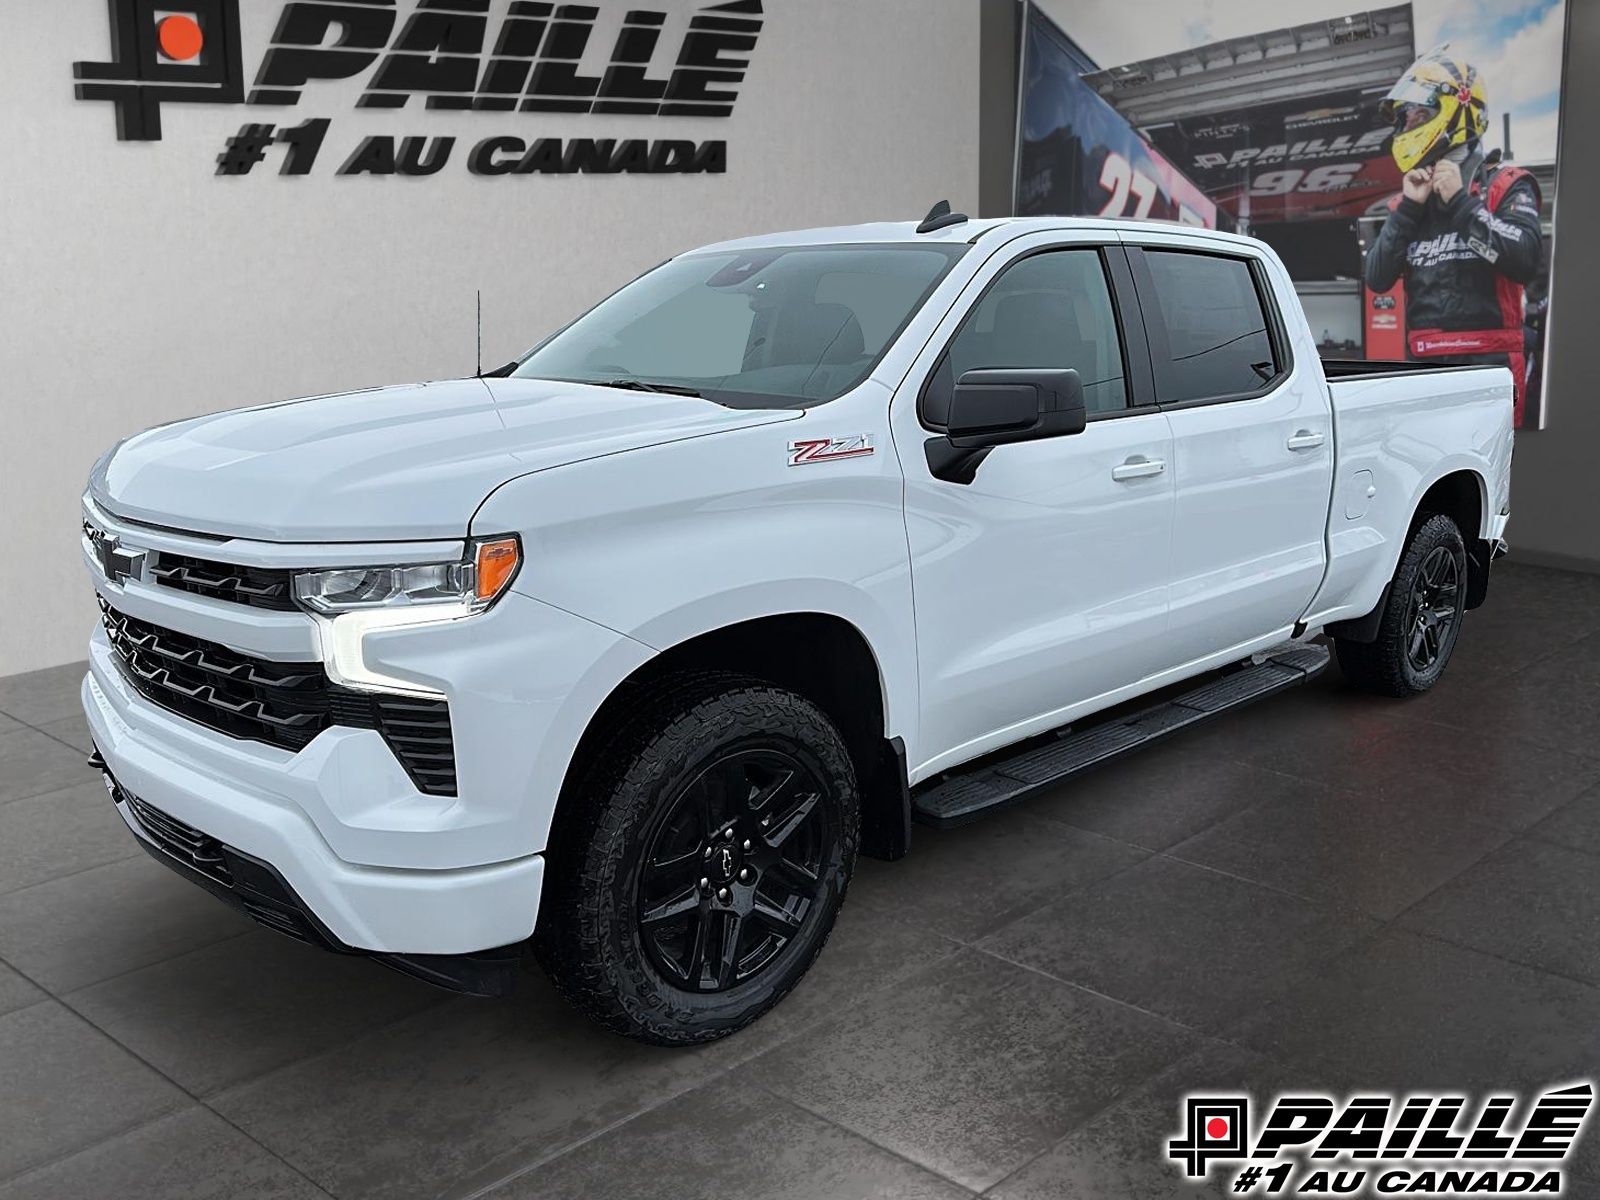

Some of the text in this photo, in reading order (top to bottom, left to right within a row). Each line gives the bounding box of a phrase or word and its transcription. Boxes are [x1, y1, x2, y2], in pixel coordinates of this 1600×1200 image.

[245, 0, 764, 117] PAILLÉ
[1285, 114, 1360, 130] CHEVROLET
[214, 118, 727, 176] #1 AU CANADA
[1289, 145, 1380, 161] CANADA
[1250, 162, 1363, 197] 96
[787, 434, 874, 466] Z71
